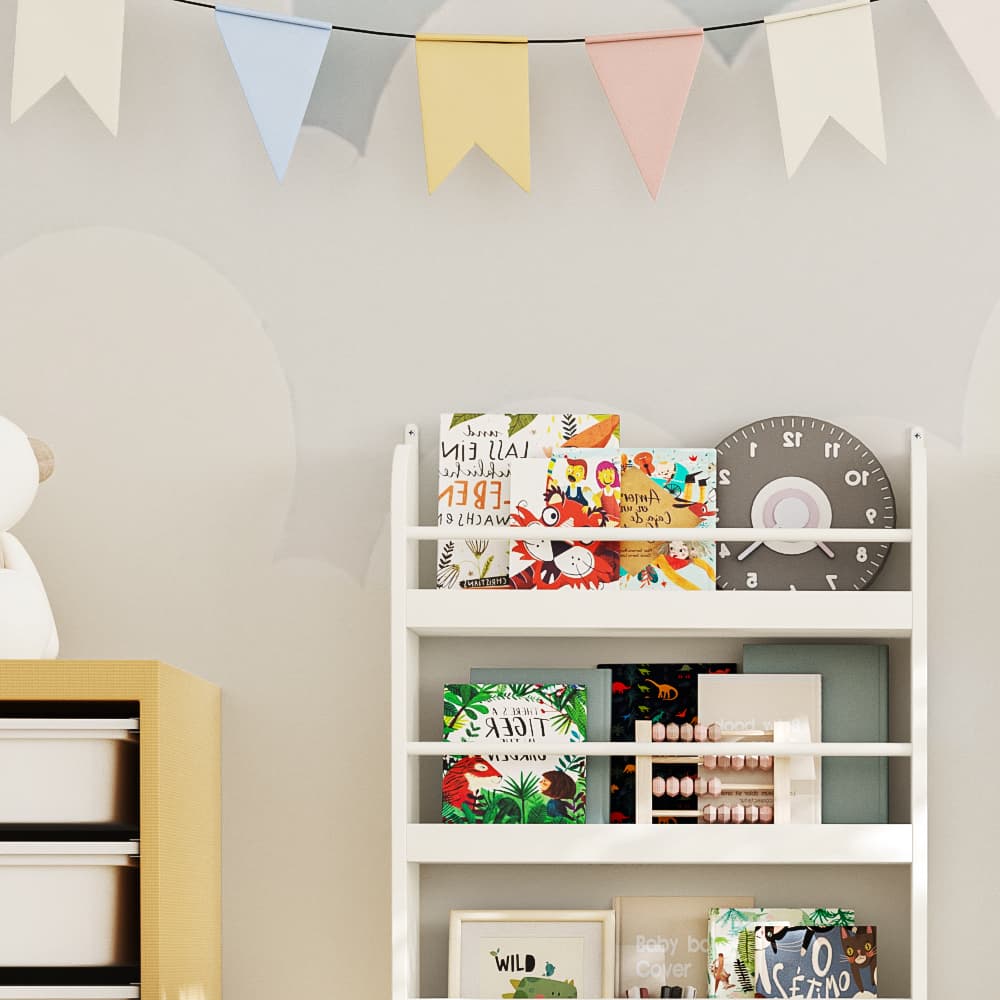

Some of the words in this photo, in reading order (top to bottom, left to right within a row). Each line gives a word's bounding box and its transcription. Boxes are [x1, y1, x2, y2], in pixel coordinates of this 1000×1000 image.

[636, 935, 679, 956] Baby
[495, 953, 536, 972] WILD
[812, 936, 833, 978] O
[635, 959, 692, 978] Cover
